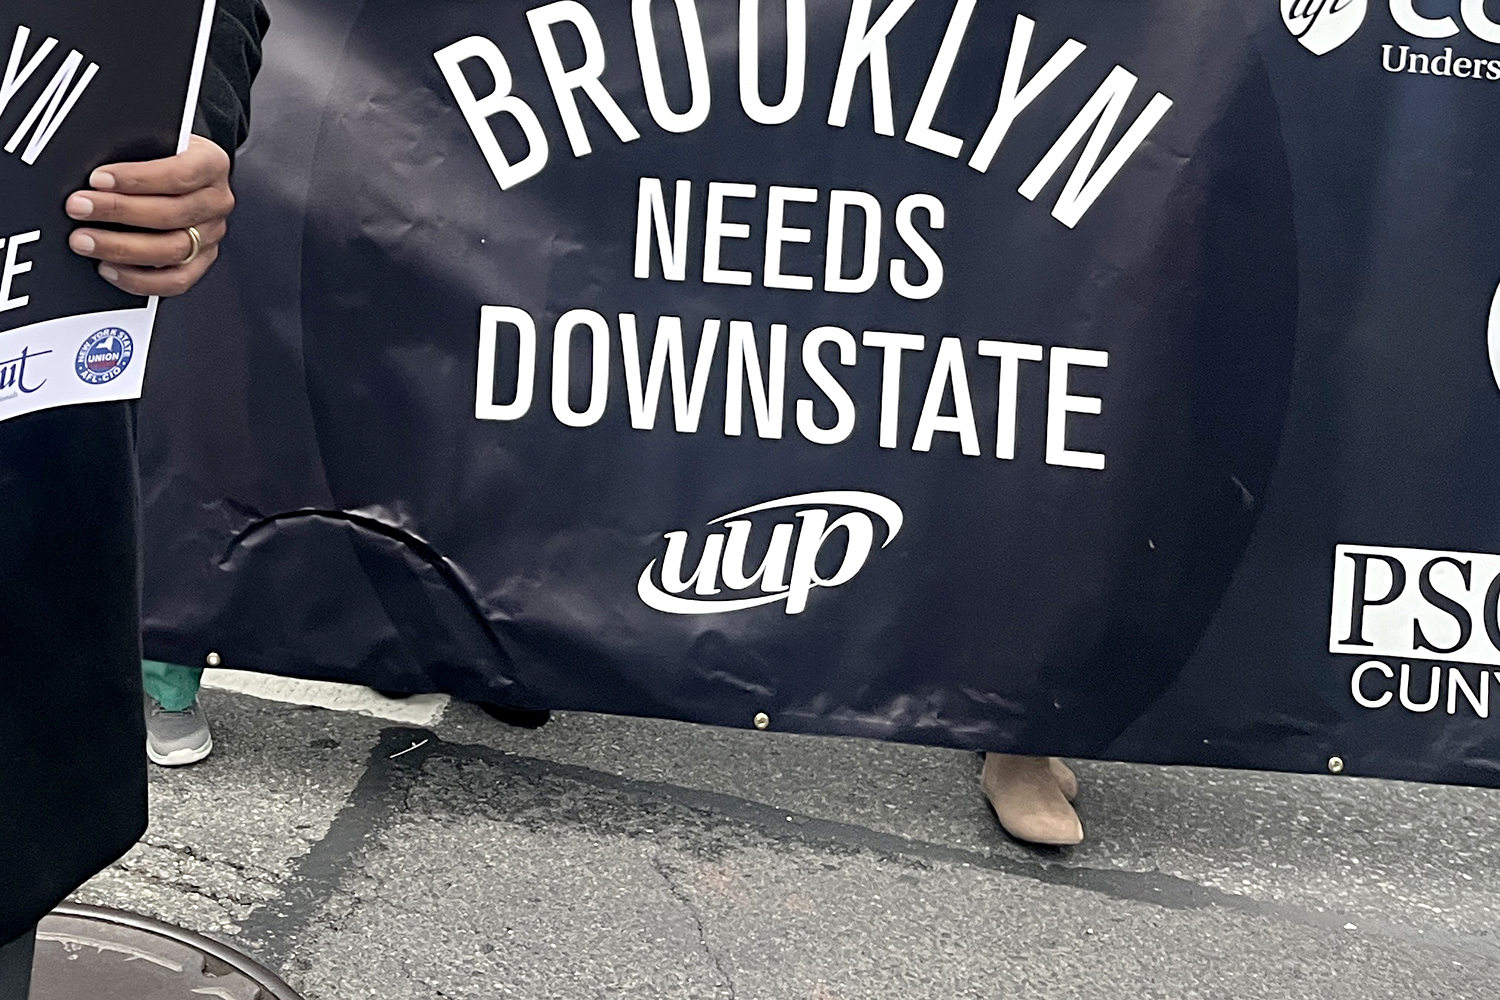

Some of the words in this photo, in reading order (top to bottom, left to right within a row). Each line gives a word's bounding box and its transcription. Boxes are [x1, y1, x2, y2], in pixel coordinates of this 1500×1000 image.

[632, 176, 945, 300] NEEDS
[77, 341, 90, 363] NEW
[91, 328, 118, 341] YORK
[117, 331, 132, 358] STATE
[87, 352, 120, 363] UNION
[474, 304, 1110, 470] DOWNSTATE
[658, 508, 876, 615] uup
[1338, 552, 1500, 653] PS
[1351, 660, 1500, 719] CUN
